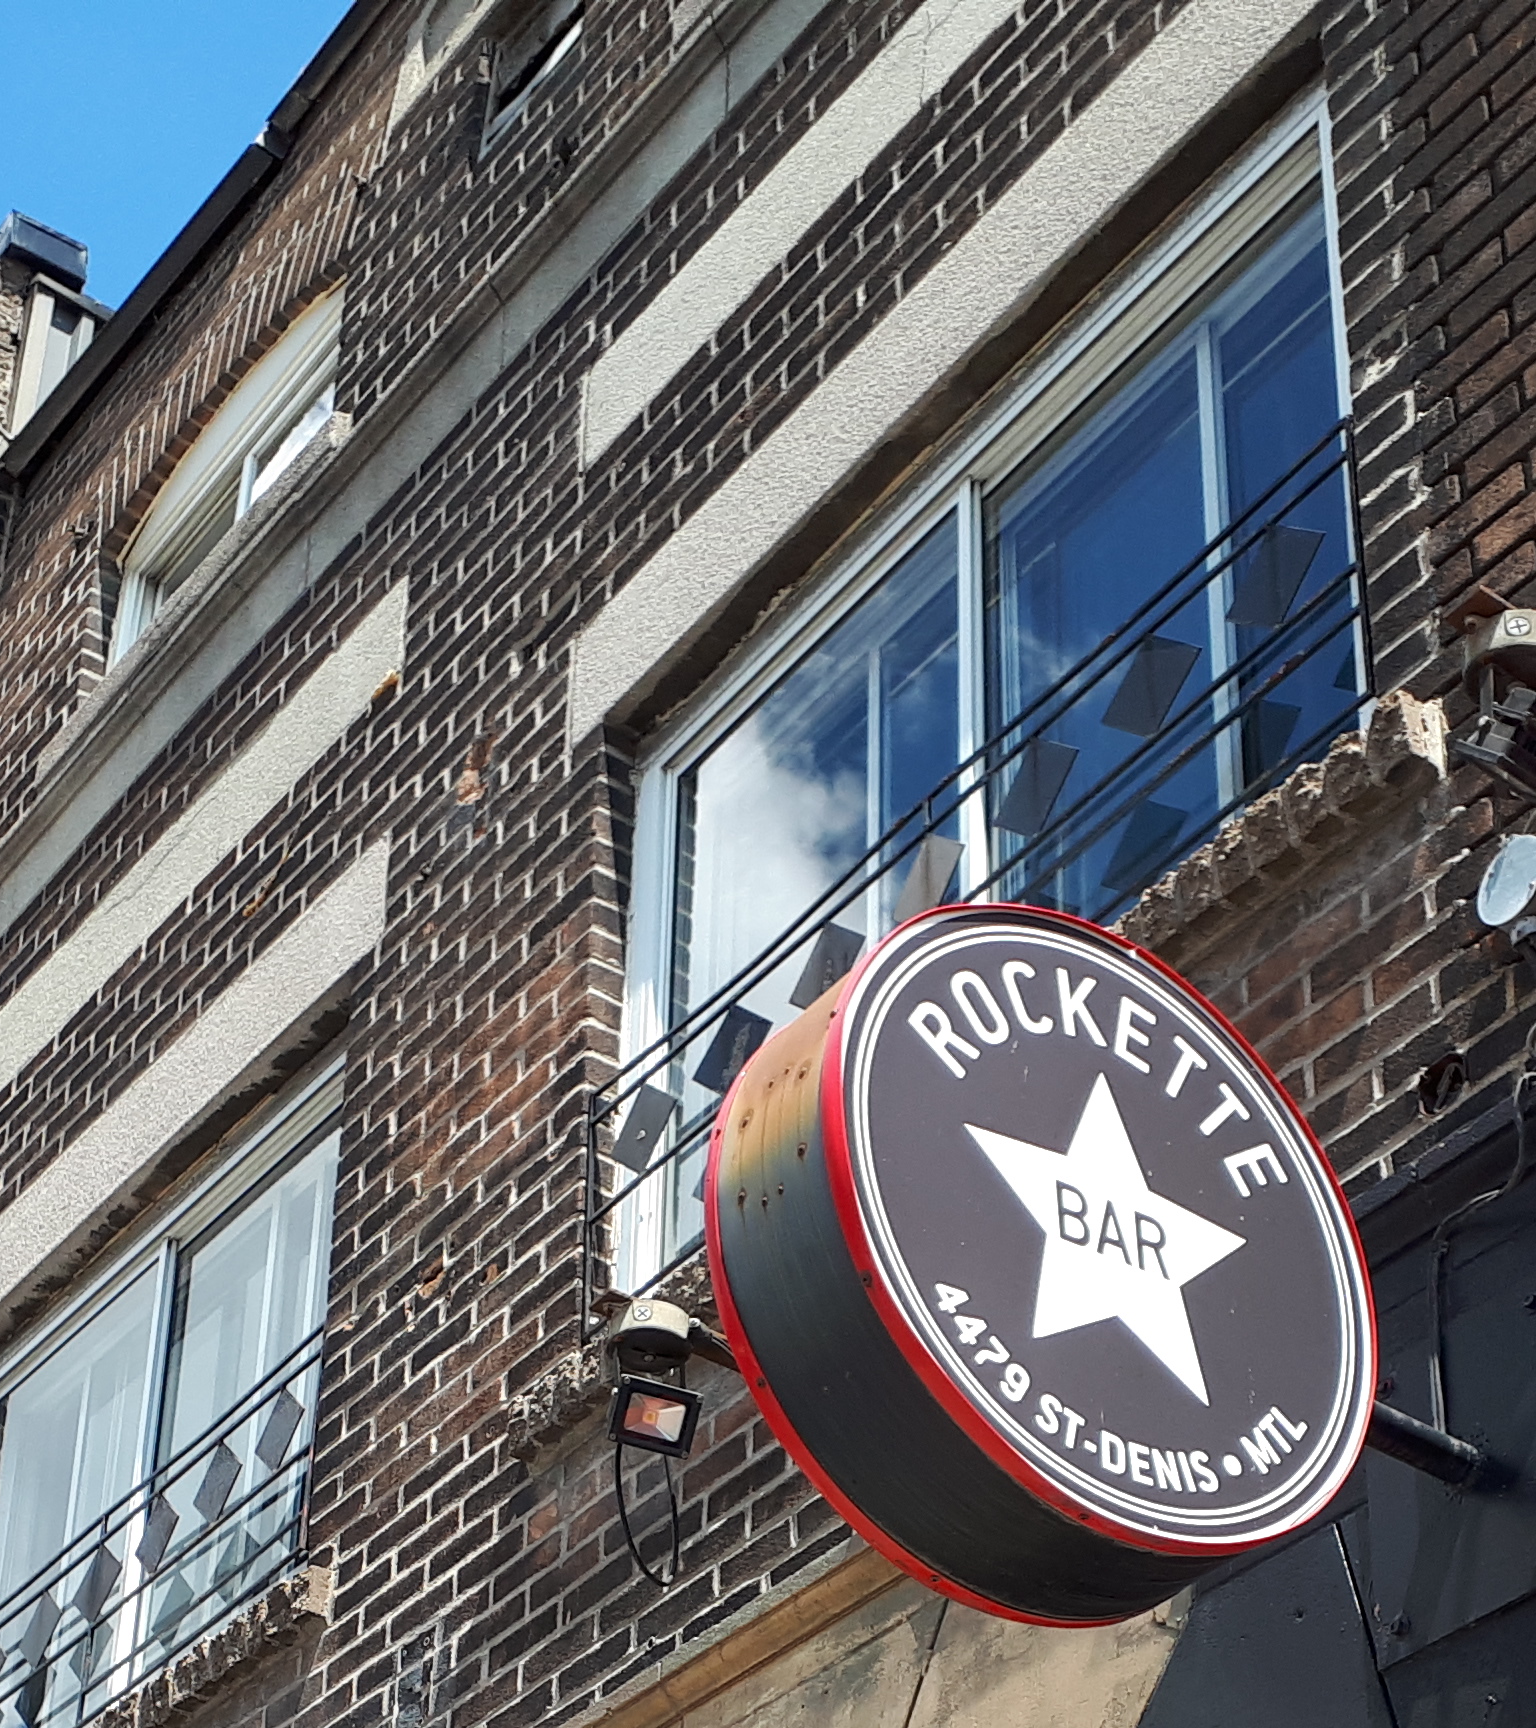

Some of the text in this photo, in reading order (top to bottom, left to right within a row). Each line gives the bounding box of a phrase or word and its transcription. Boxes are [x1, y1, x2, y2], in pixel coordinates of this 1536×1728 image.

[907, 959, 1289, 1198] ROCKETTE
[1054, 1179, 1170, 1281] BAR
[933, 1280, 1308, 1494] 4479 ST-DENIS MTL
